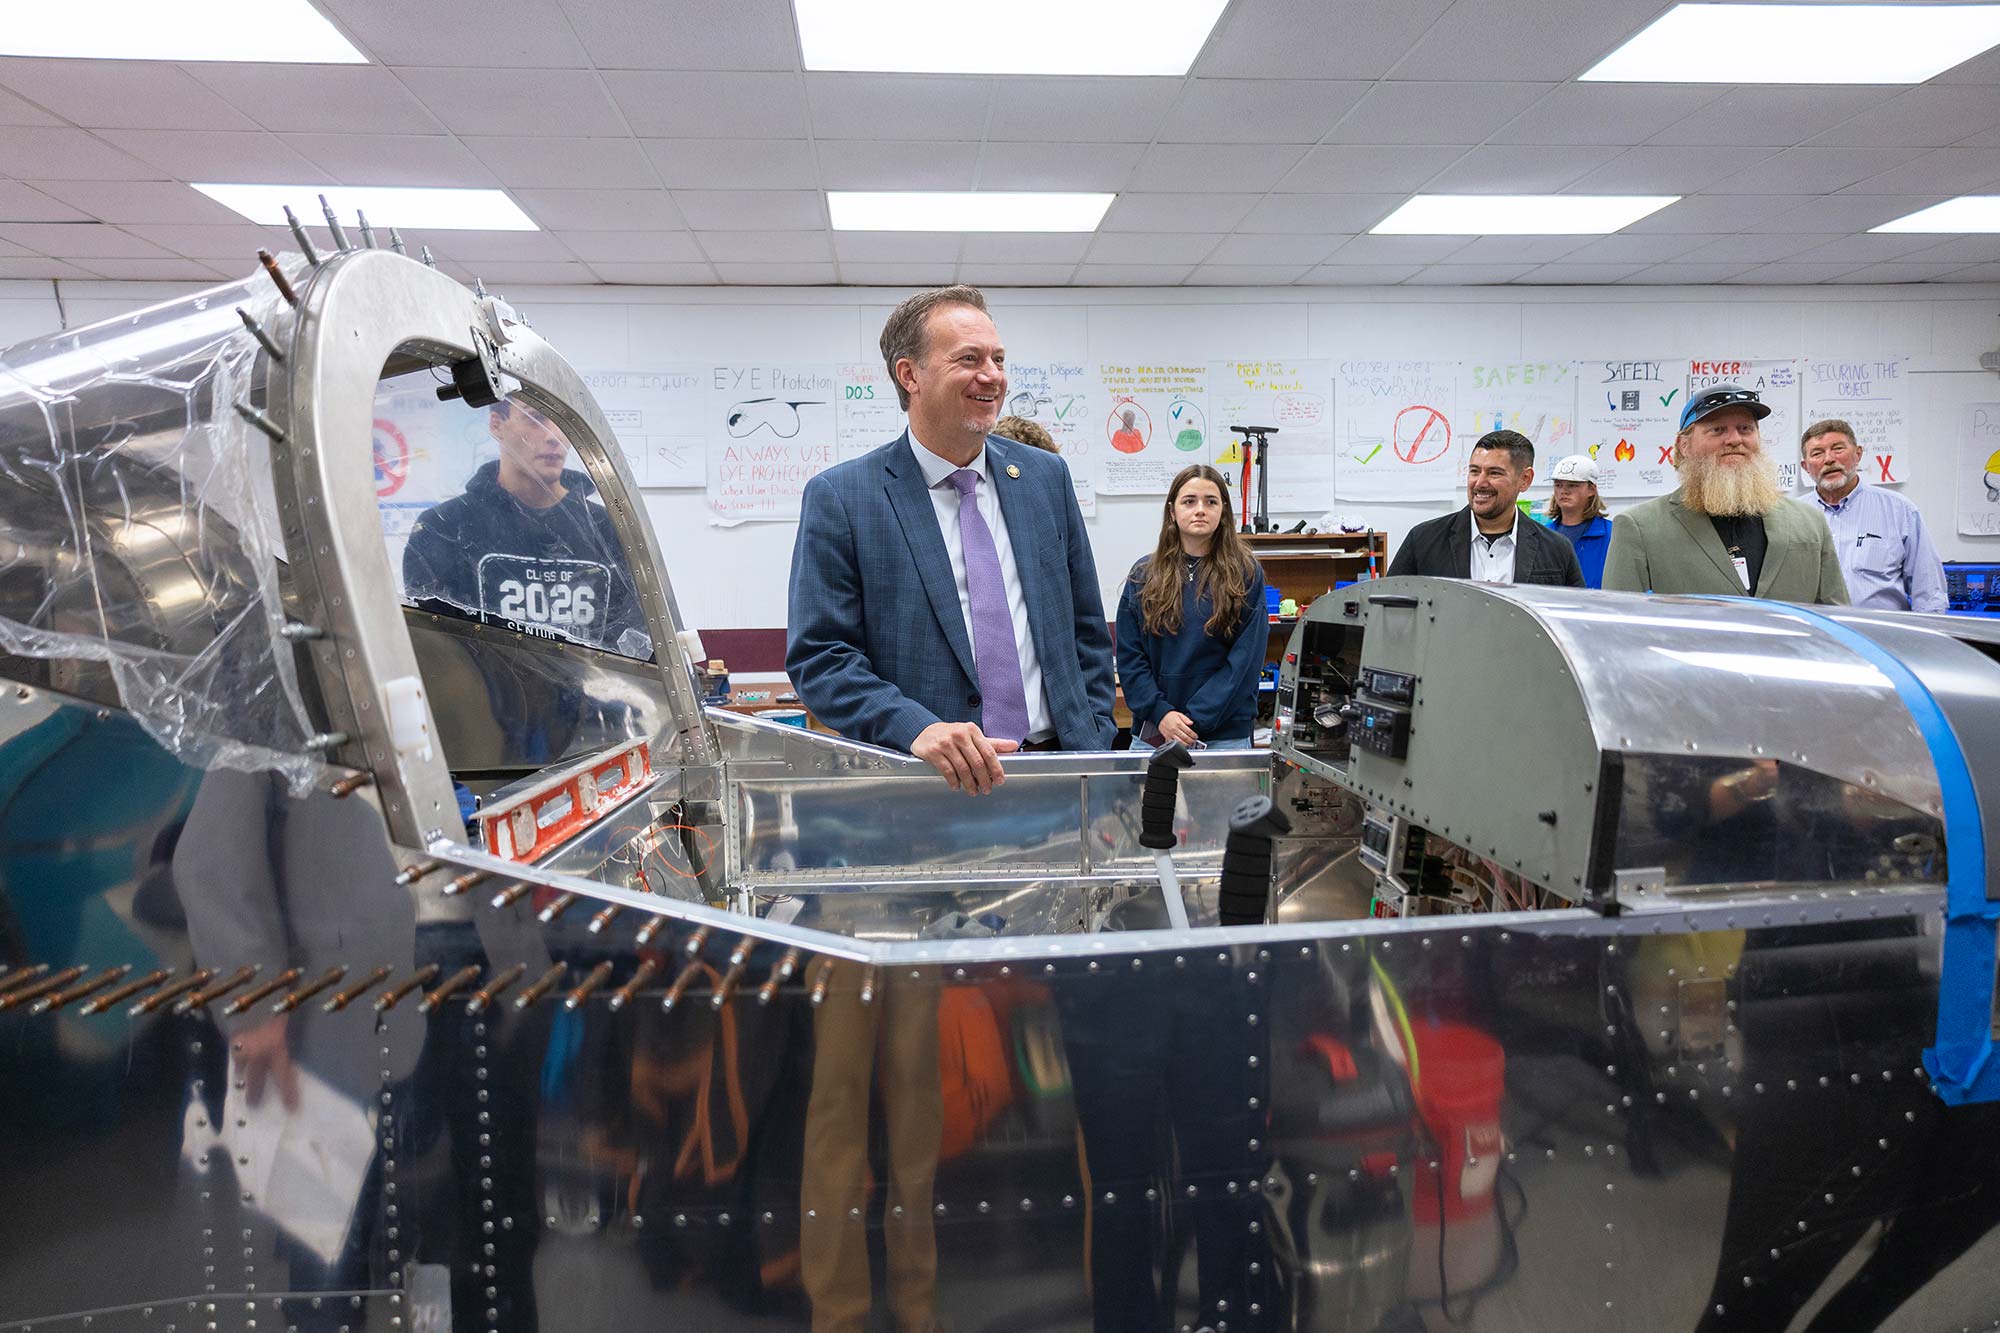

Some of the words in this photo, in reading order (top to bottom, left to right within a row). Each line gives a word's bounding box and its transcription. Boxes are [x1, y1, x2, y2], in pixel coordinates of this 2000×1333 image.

[714, 368, 761, 390] EYE
[772, 368, 832, 390] Protection
[1605, 361, 1662, 381] SAFETY
[1811, 363, 1869, 384] SECURING
[1874, 362, 1899, 380] THE
[1756, 376, 1766, 389] A
[1838, 381, 1873, 397] OBJECT
[845, 385, 875, 400] DO'S
[724, 446, 790, 462] ALWAYS
[800, 446, 832, 462] USE
[525, 569, 557, 582] CLSS
[560, 571, 574, 582] OF
[500, 580, 596, 625] 2026
